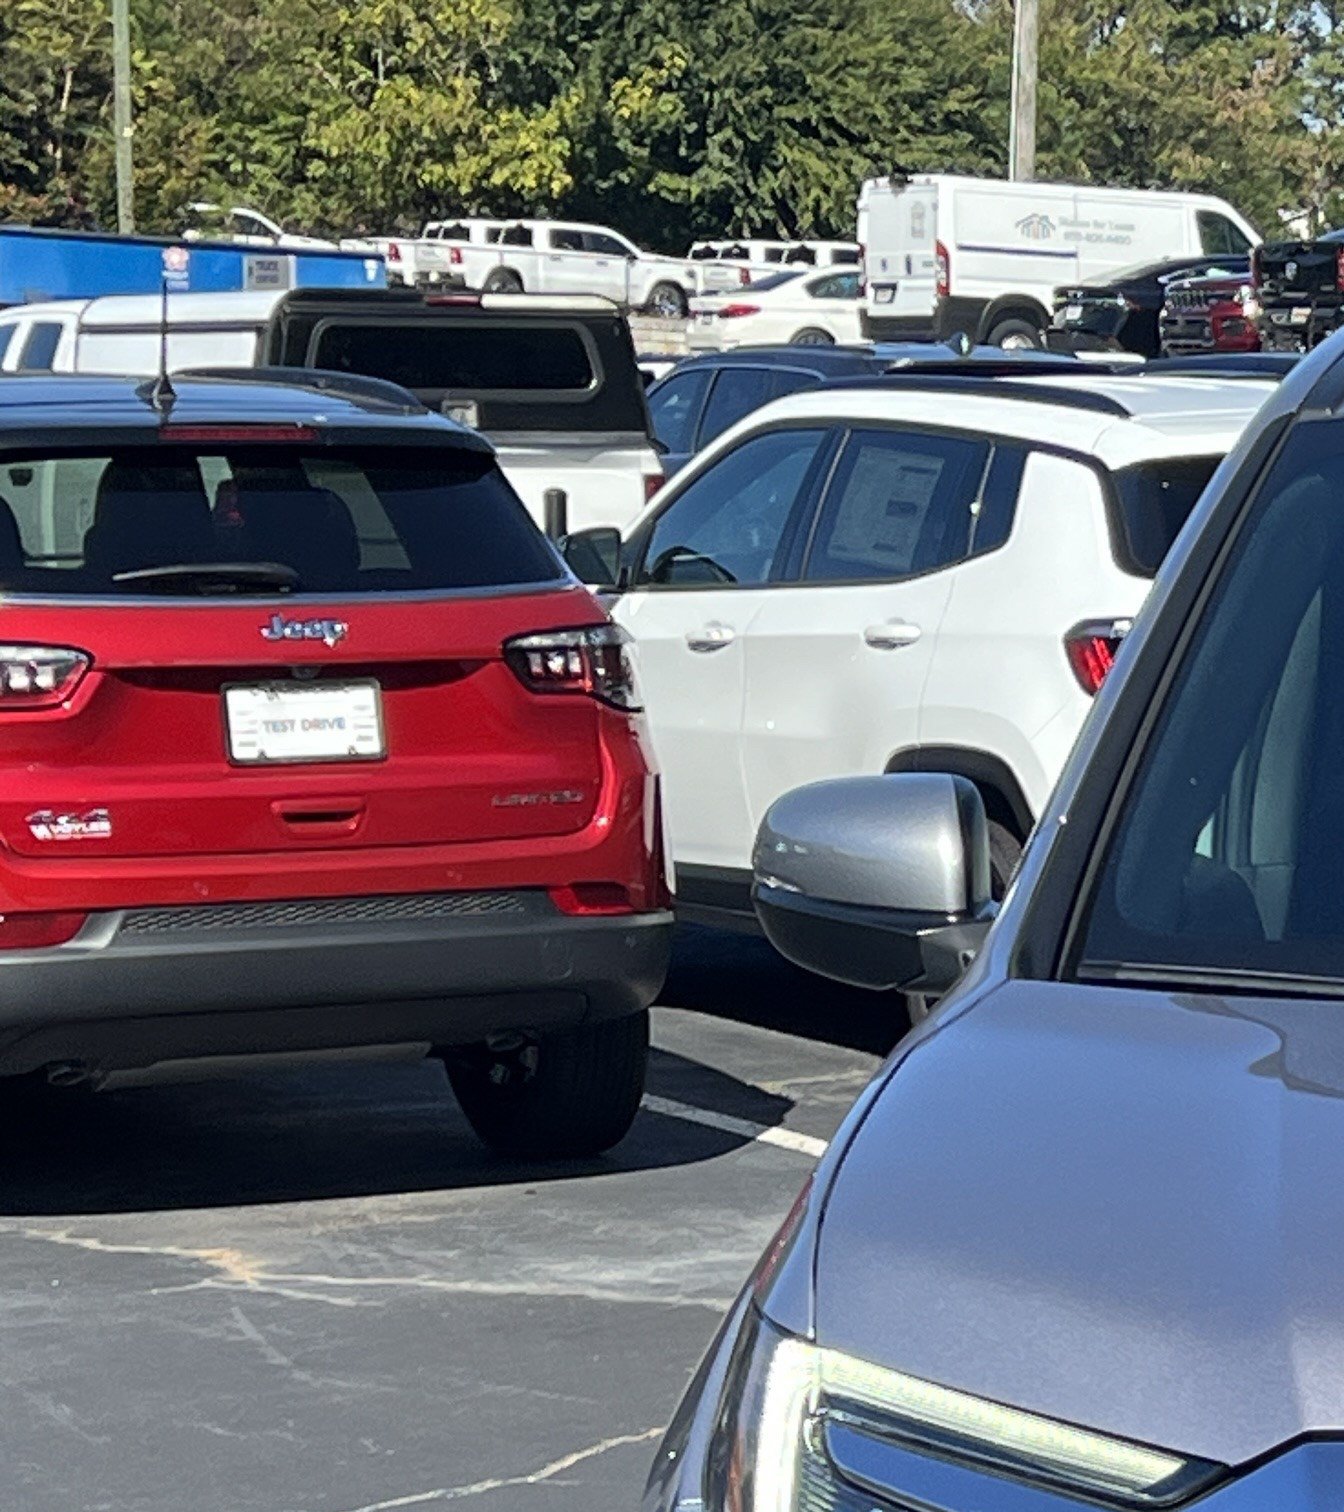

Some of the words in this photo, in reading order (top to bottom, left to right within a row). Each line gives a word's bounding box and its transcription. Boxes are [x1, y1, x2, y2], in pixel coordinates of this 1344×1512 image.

[260, 613, 349, 649] Jeep
[262, 719, 296, 733] TEST
[301, 717, 346, 732] DRIVE
